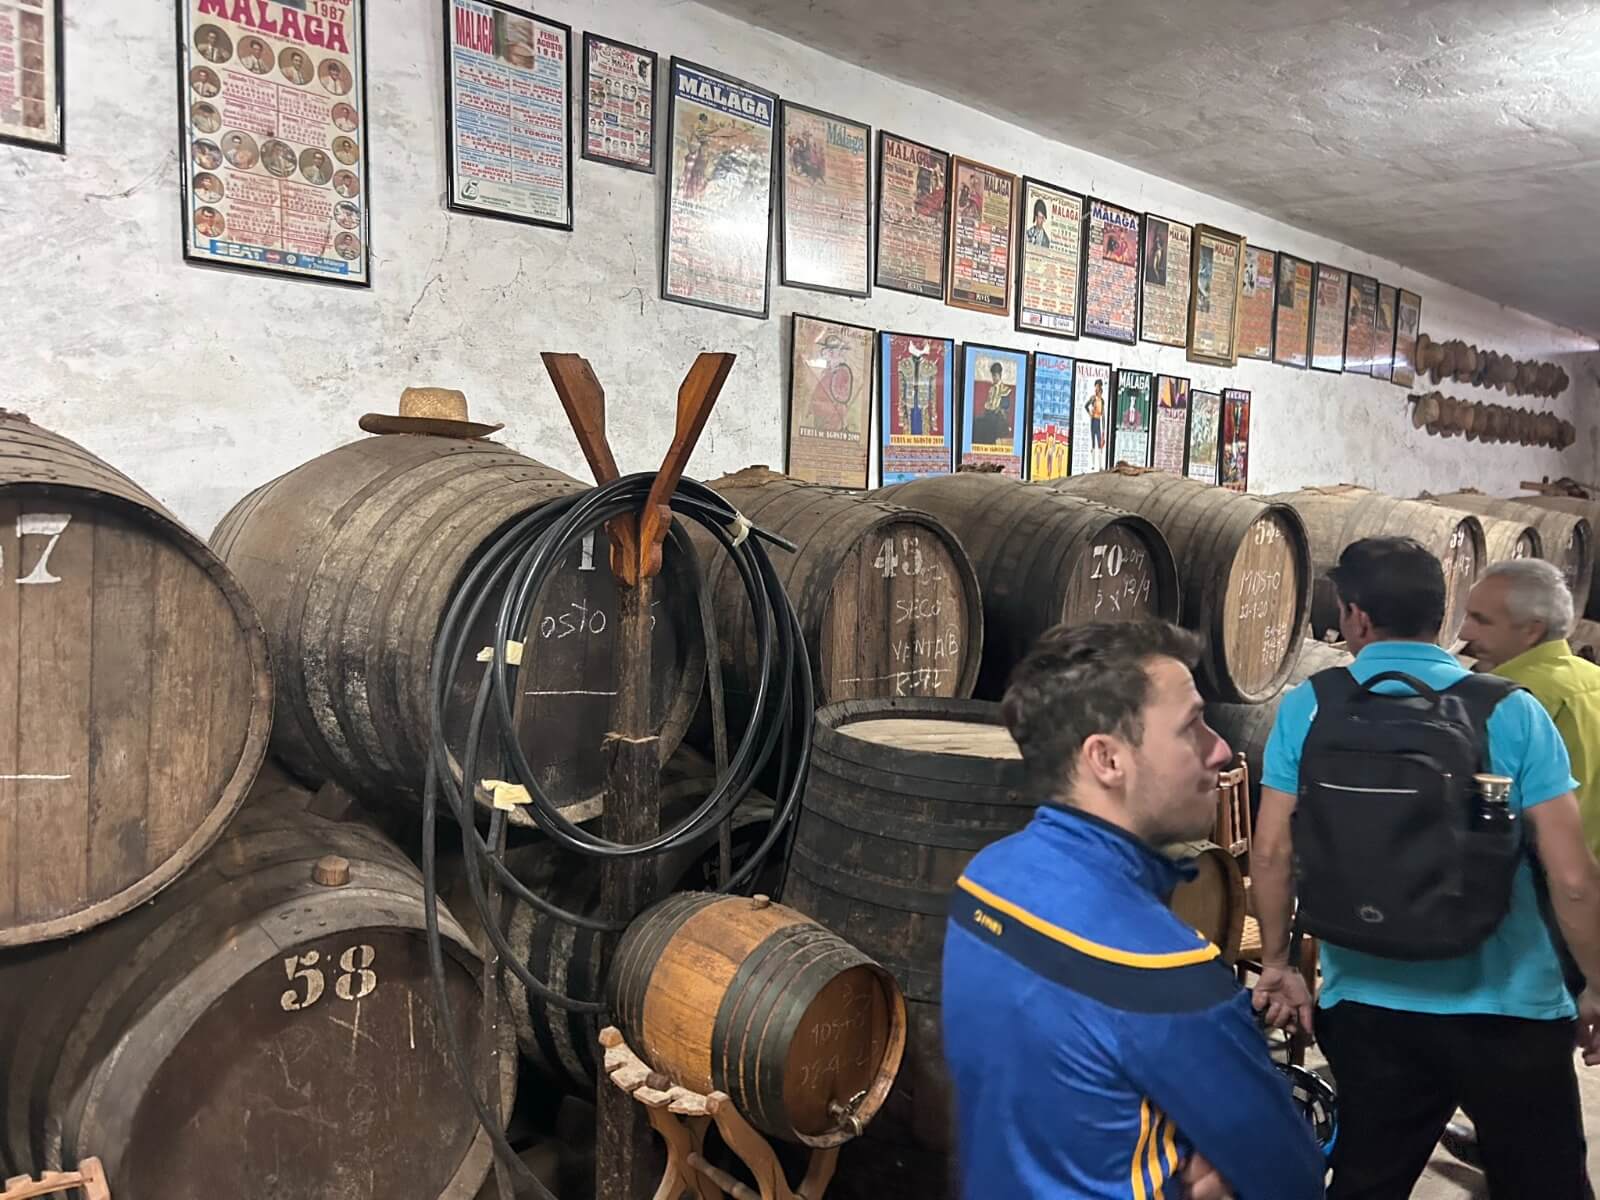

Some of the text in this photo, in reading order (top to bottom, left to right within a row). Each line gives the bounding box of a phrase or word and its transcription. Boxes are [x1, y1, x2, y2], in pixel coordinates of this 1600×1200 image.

[197, 0, 350, 55] MALAGA
[313, 1, 345, 22] 1987
[679, 74, 769, 120] MALAGA
[1051, 204, 1080, 221] MALAGA
[1092, 206, 1137, 231] MALAGA
[800, 426, 817, 438] FERIA
[0, 512, 72, 584] 7
[873, 537, 923, 578] 45
[1090, 544, 1123, 579] 70
[541, 598, 607, 638] OSTO
[280, 944, 377, 1011] 58
